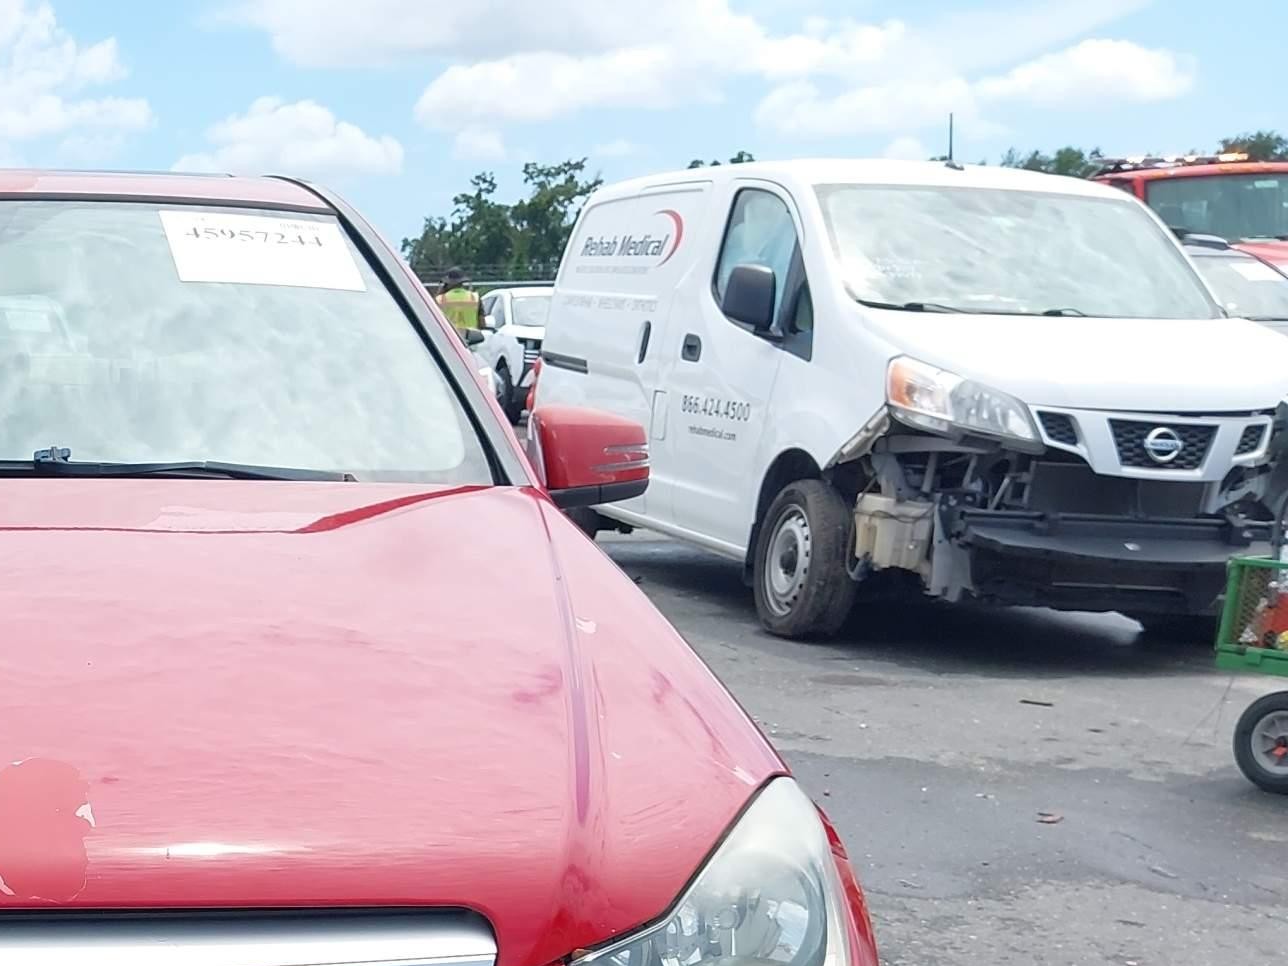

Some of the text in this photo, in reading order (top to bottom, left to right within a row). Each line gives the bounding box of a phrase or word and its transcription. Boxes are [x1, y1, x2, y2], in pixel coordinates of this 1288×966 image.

[185, 226, 323, 247] 45957244
[580, 234, 670, 256] Rehab Medical
[682, 395, 750, 421] 866.424.4500
